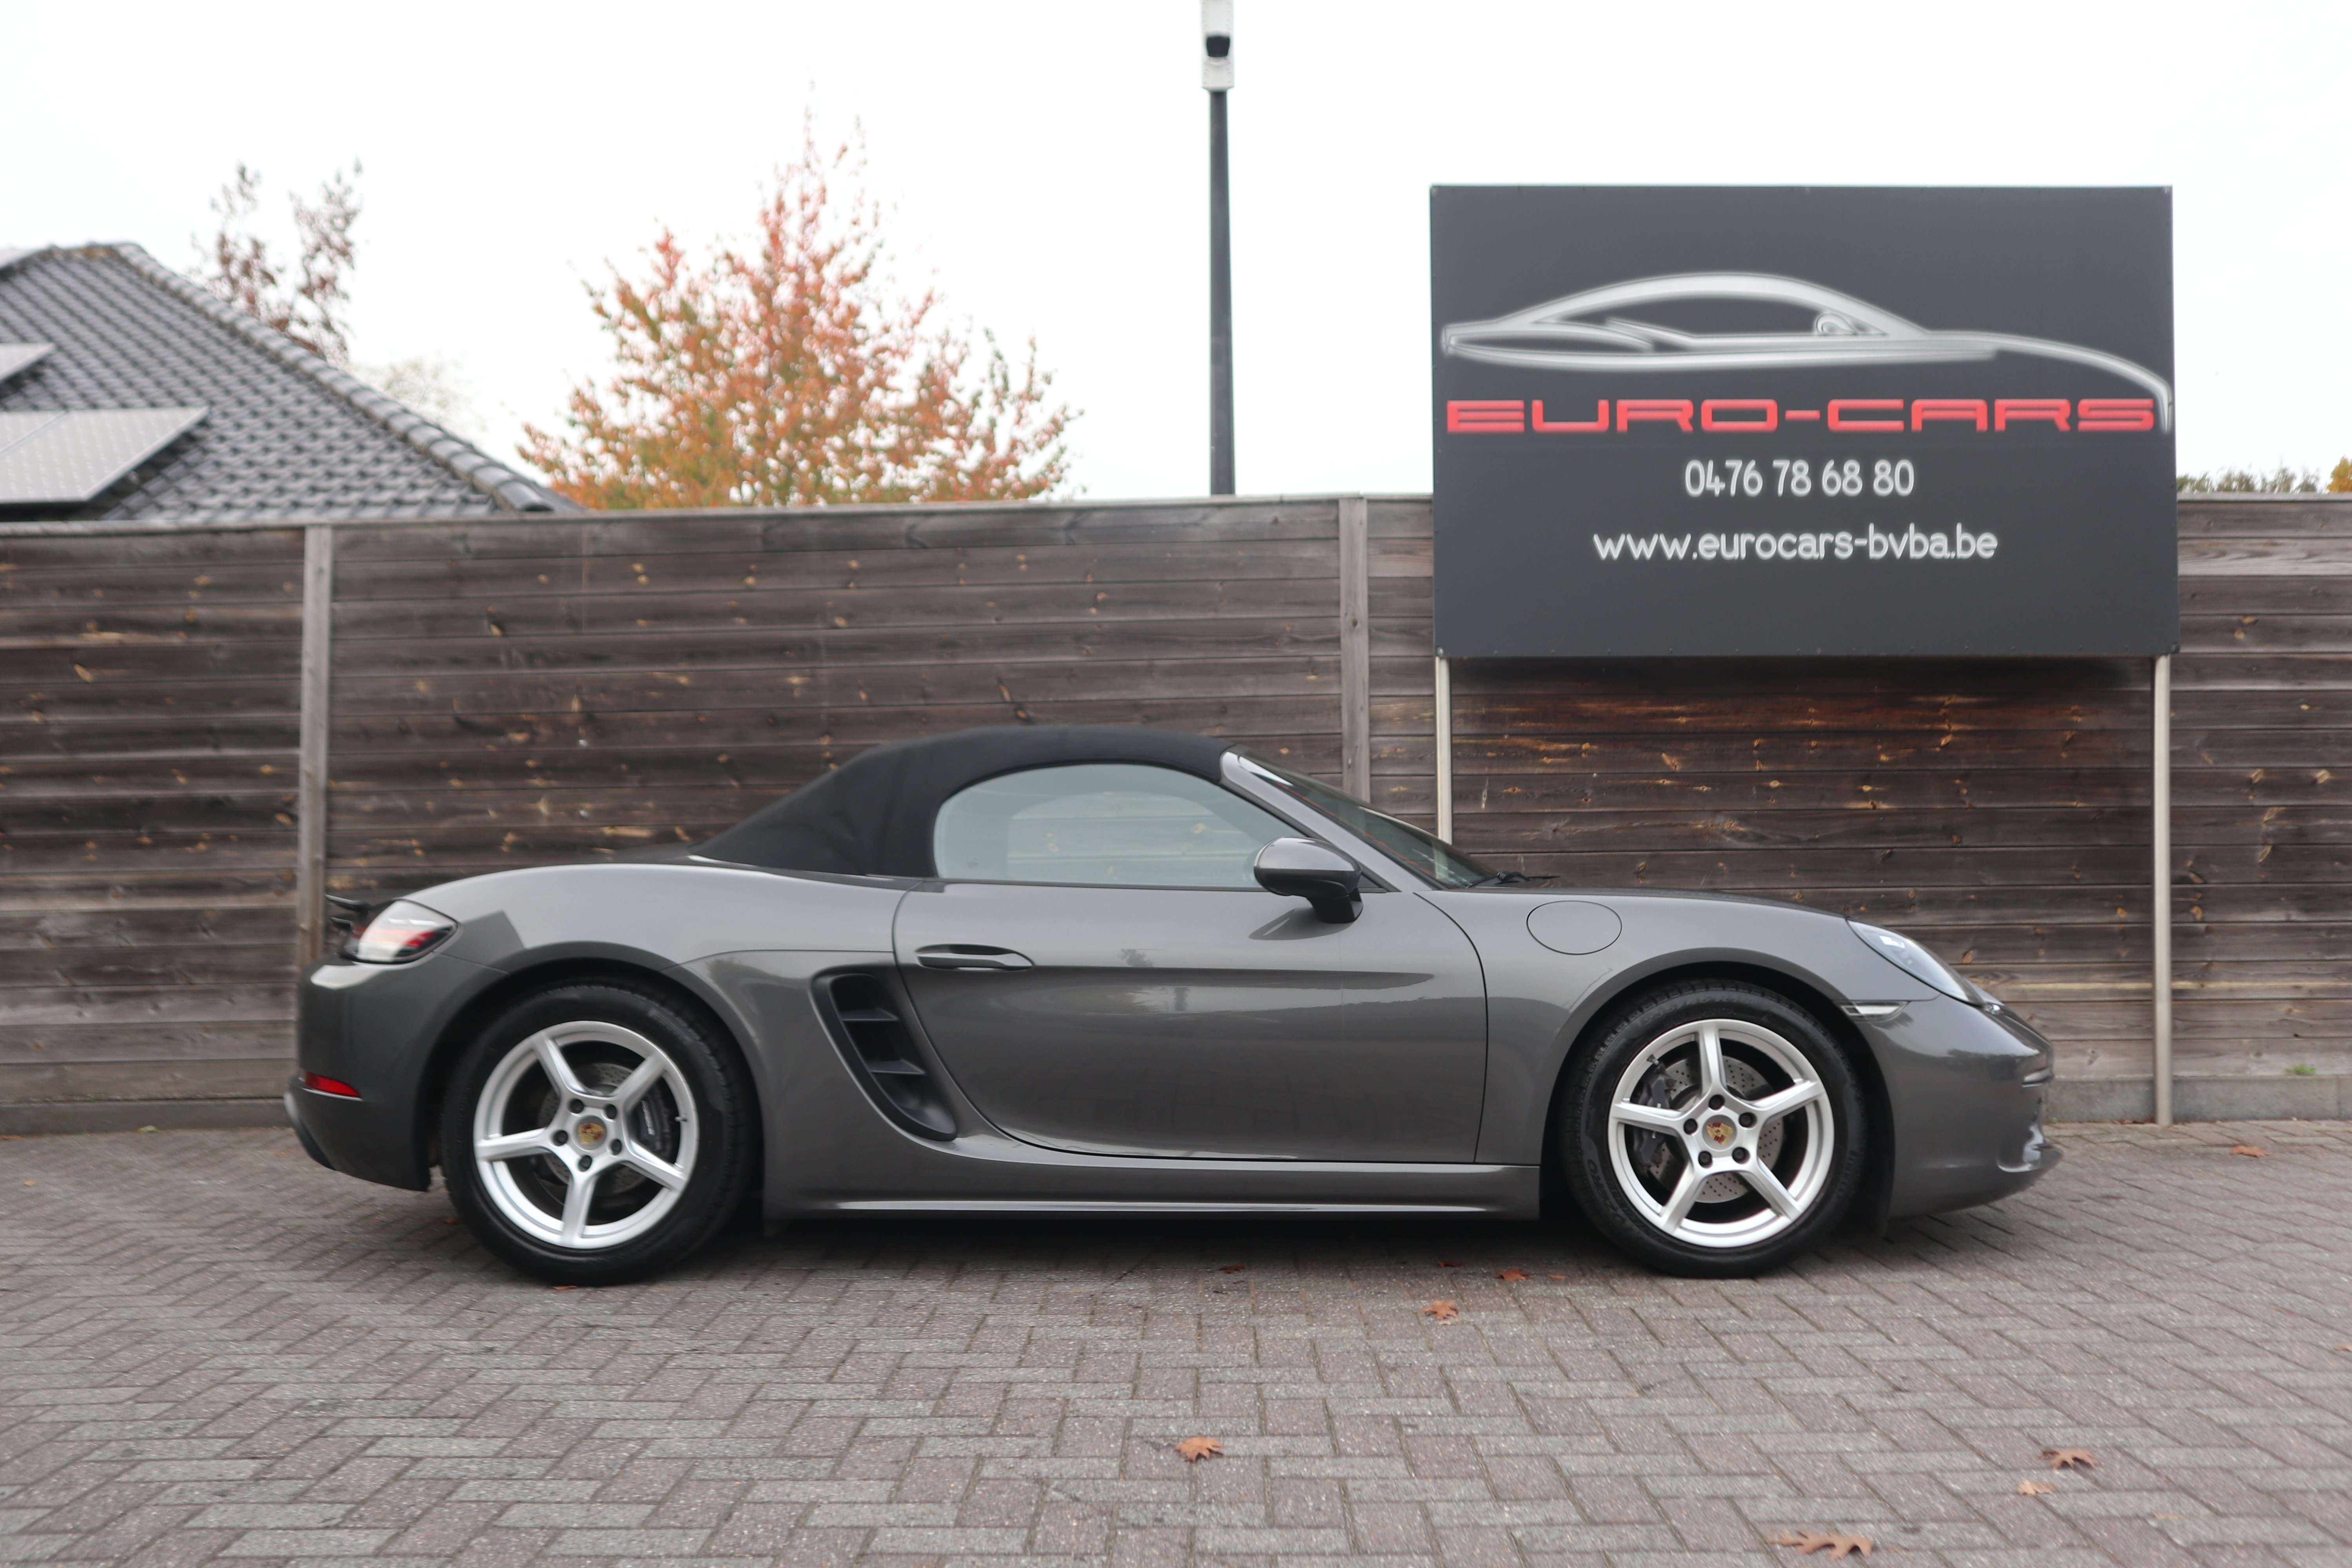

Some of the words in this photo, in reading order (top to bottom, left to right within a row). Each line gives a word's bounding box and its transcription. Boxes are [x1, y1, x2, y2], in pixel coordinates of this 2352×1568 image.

[1447, 399, 2154, 432] EURO-CARS
[1685, 459, 1763, 497] 0476
[1773, 459, 1811, 497] 78
[1822, 459, 1863, 497] 68
[1873, 459, 1915, 497] 80
[1593, 523, 1998, 561] www.eurocars-bvba.be
